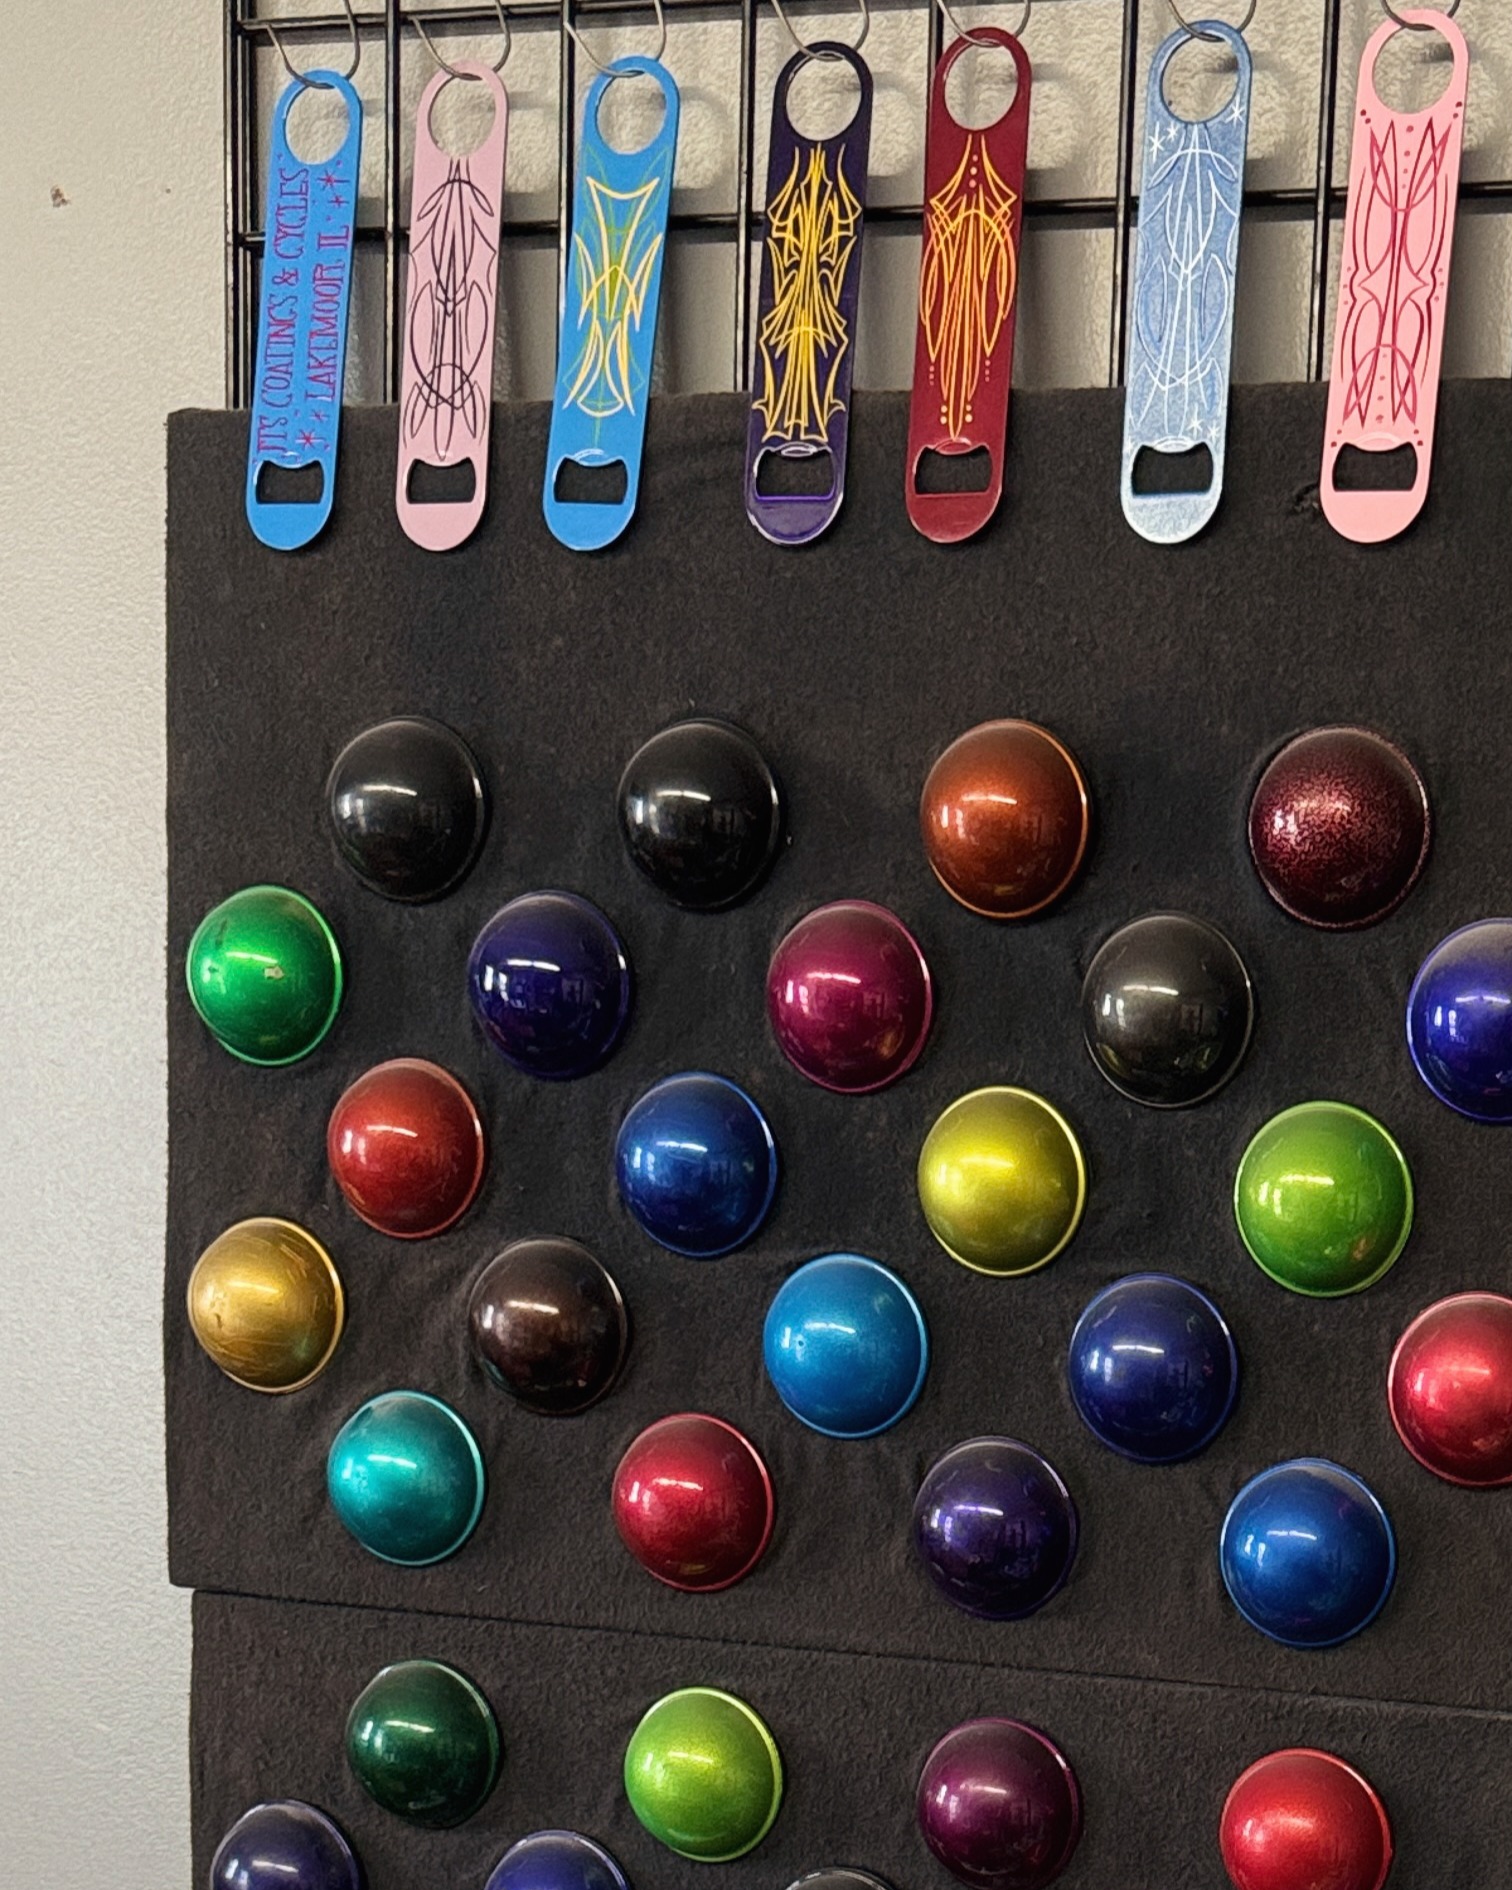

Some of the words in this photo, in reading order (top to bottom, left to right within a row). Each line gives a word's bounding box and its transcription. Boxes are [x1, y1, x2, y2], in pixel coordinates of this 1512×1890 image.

[274, 167, 310, 260] CYCLES
[317, 225, 350, 250] IL
[271, 267, 299, 286] &
[261, 293, 298, 409] COATINGS
[305, 260, 346, 402] LAKEMOOR
[257, 415, 288, 452] JTS
